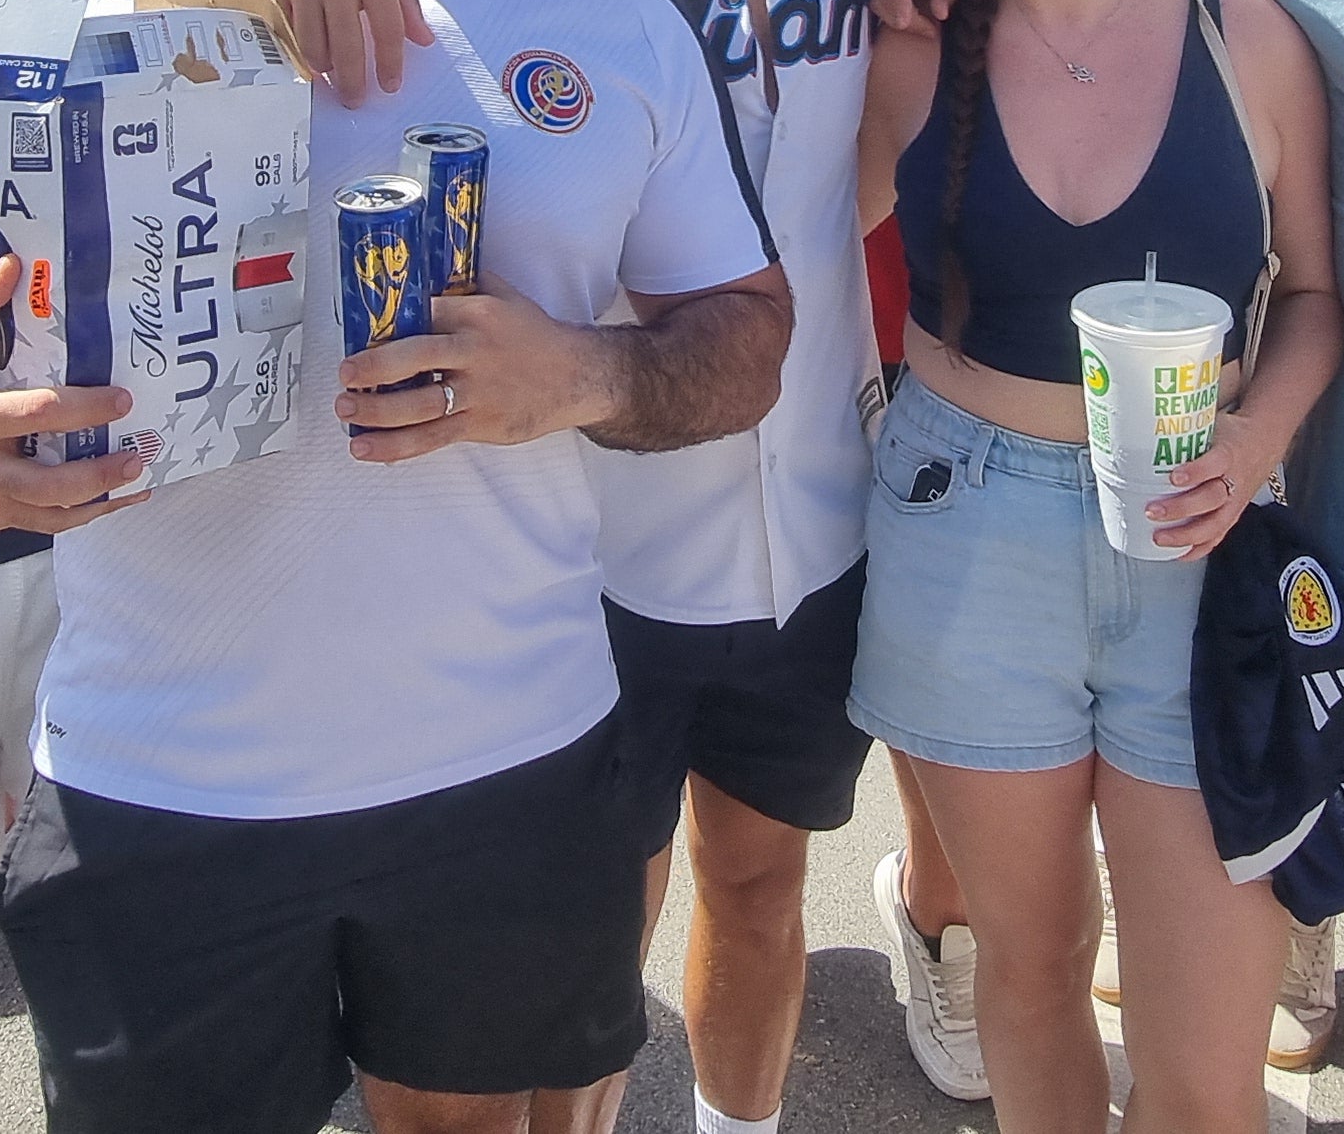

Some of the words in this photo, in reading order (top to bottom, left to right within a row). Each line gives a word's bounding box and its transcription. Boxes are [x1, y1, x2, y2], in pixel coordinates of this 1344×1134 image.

[16, 70, 42, 89] 12
[255, 155, 270, 187] 95
[272, 153, 281, 185] CALS
[129, 215, 168, 378] Michelob
[172, 159, 220, 403] ULTRA
[255, 360, 270, 397] 2.6
[271, 356, 279, 395] CARBS
[1178, 353, 1223, 393] EA
[1155, 383, 1219, 417] REWAR
[1154, 416, 1191, 436] AND
